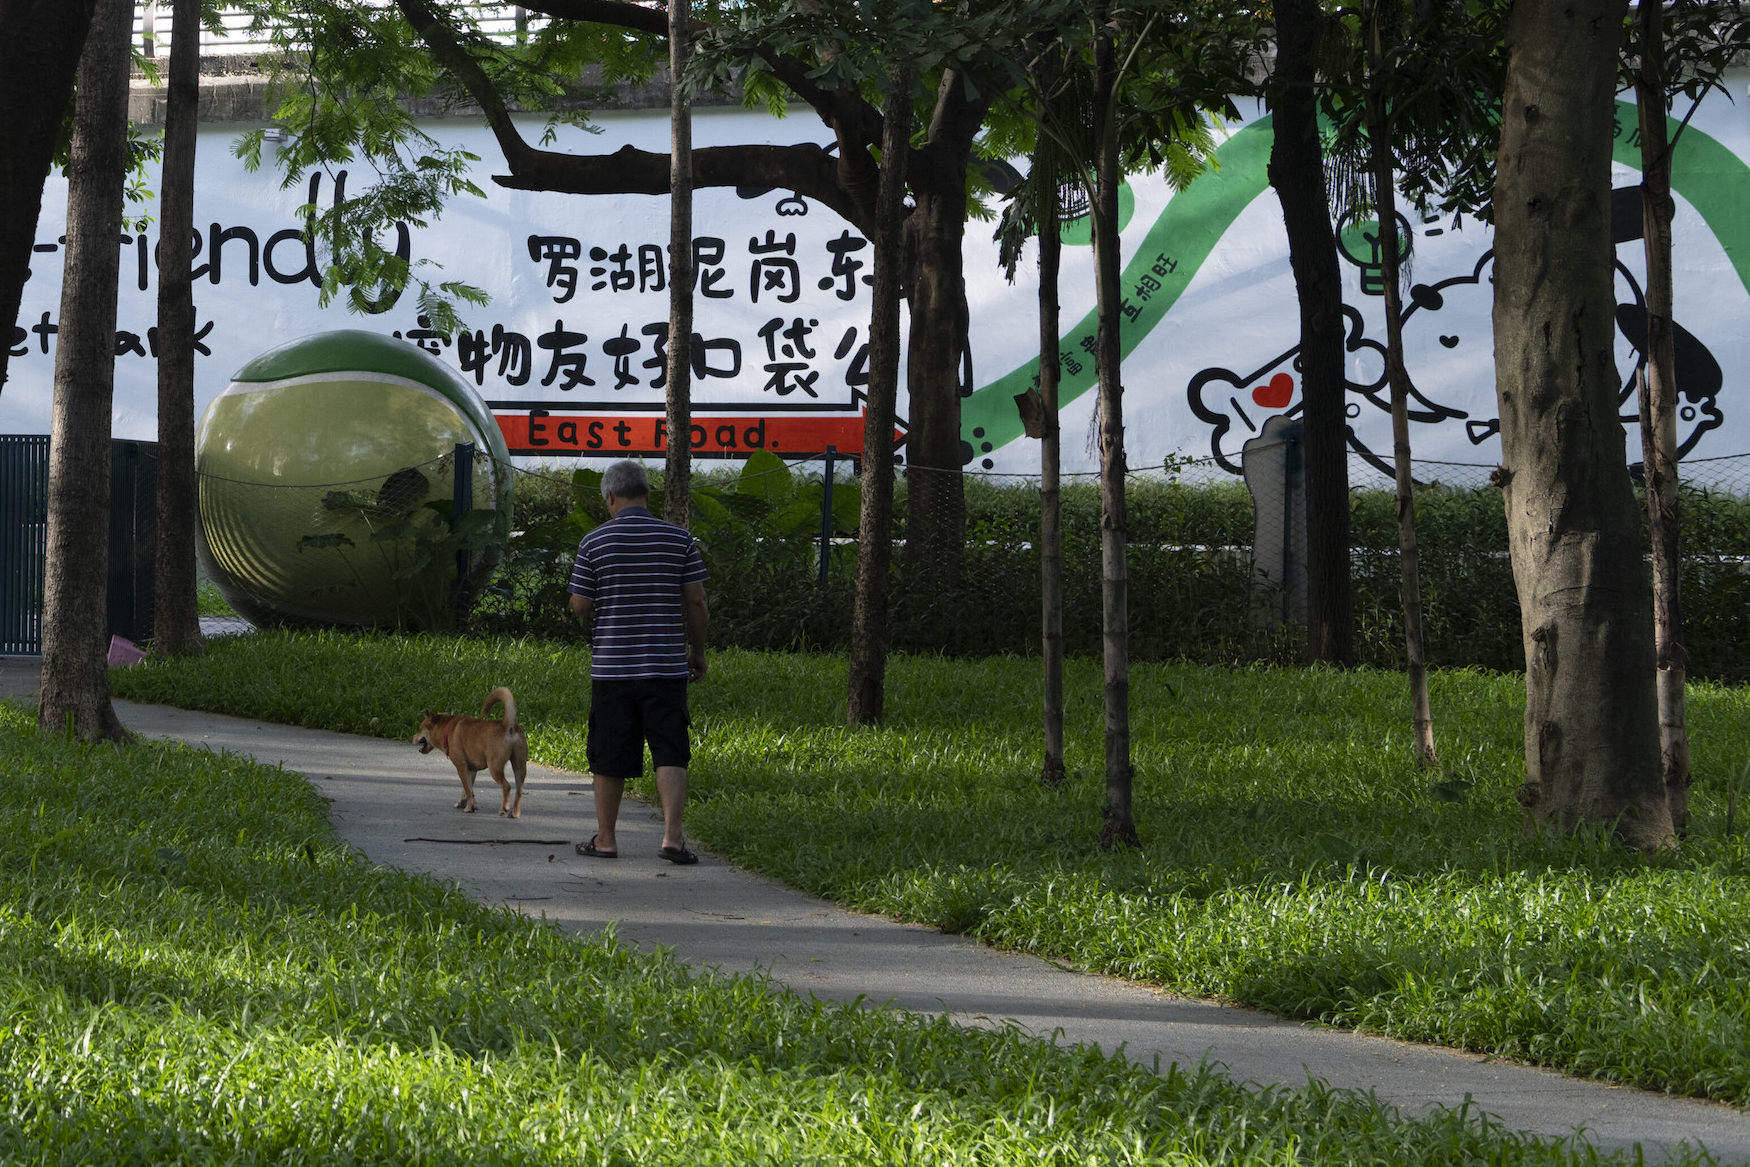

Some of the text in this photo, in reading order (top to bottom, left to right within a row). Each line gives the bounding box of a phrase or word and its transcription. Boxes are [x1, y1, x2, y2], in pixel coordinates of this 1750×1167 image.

[527, 229, 907, 304] 罗湖泥岗东
[393, 315, 974, 398] 物友好口袋公
[528, 409, 632, 449] East
